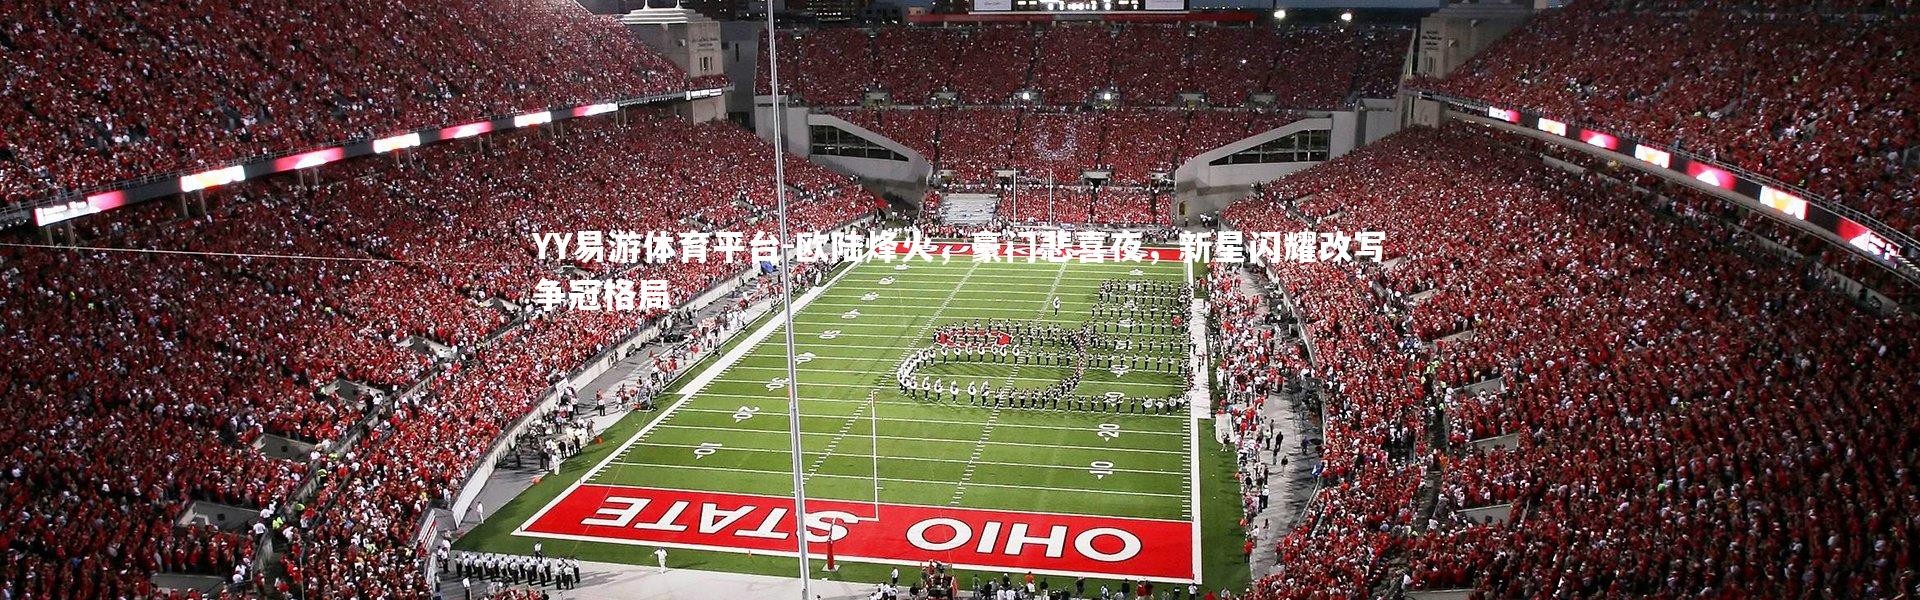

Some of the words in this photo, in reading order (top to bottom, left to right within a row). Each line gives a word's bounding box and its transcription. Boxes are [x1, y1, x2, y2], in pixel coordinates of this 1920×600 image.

[732, 406, 760, 419] 20
[1097, 423, 1120, 437] 20
[693, 442, 723, 455] 10
[1089, 461, 1114, 475] 10
[580, 496, 859, 543] STATE
[906, 517, 1142, 562] OHIO
